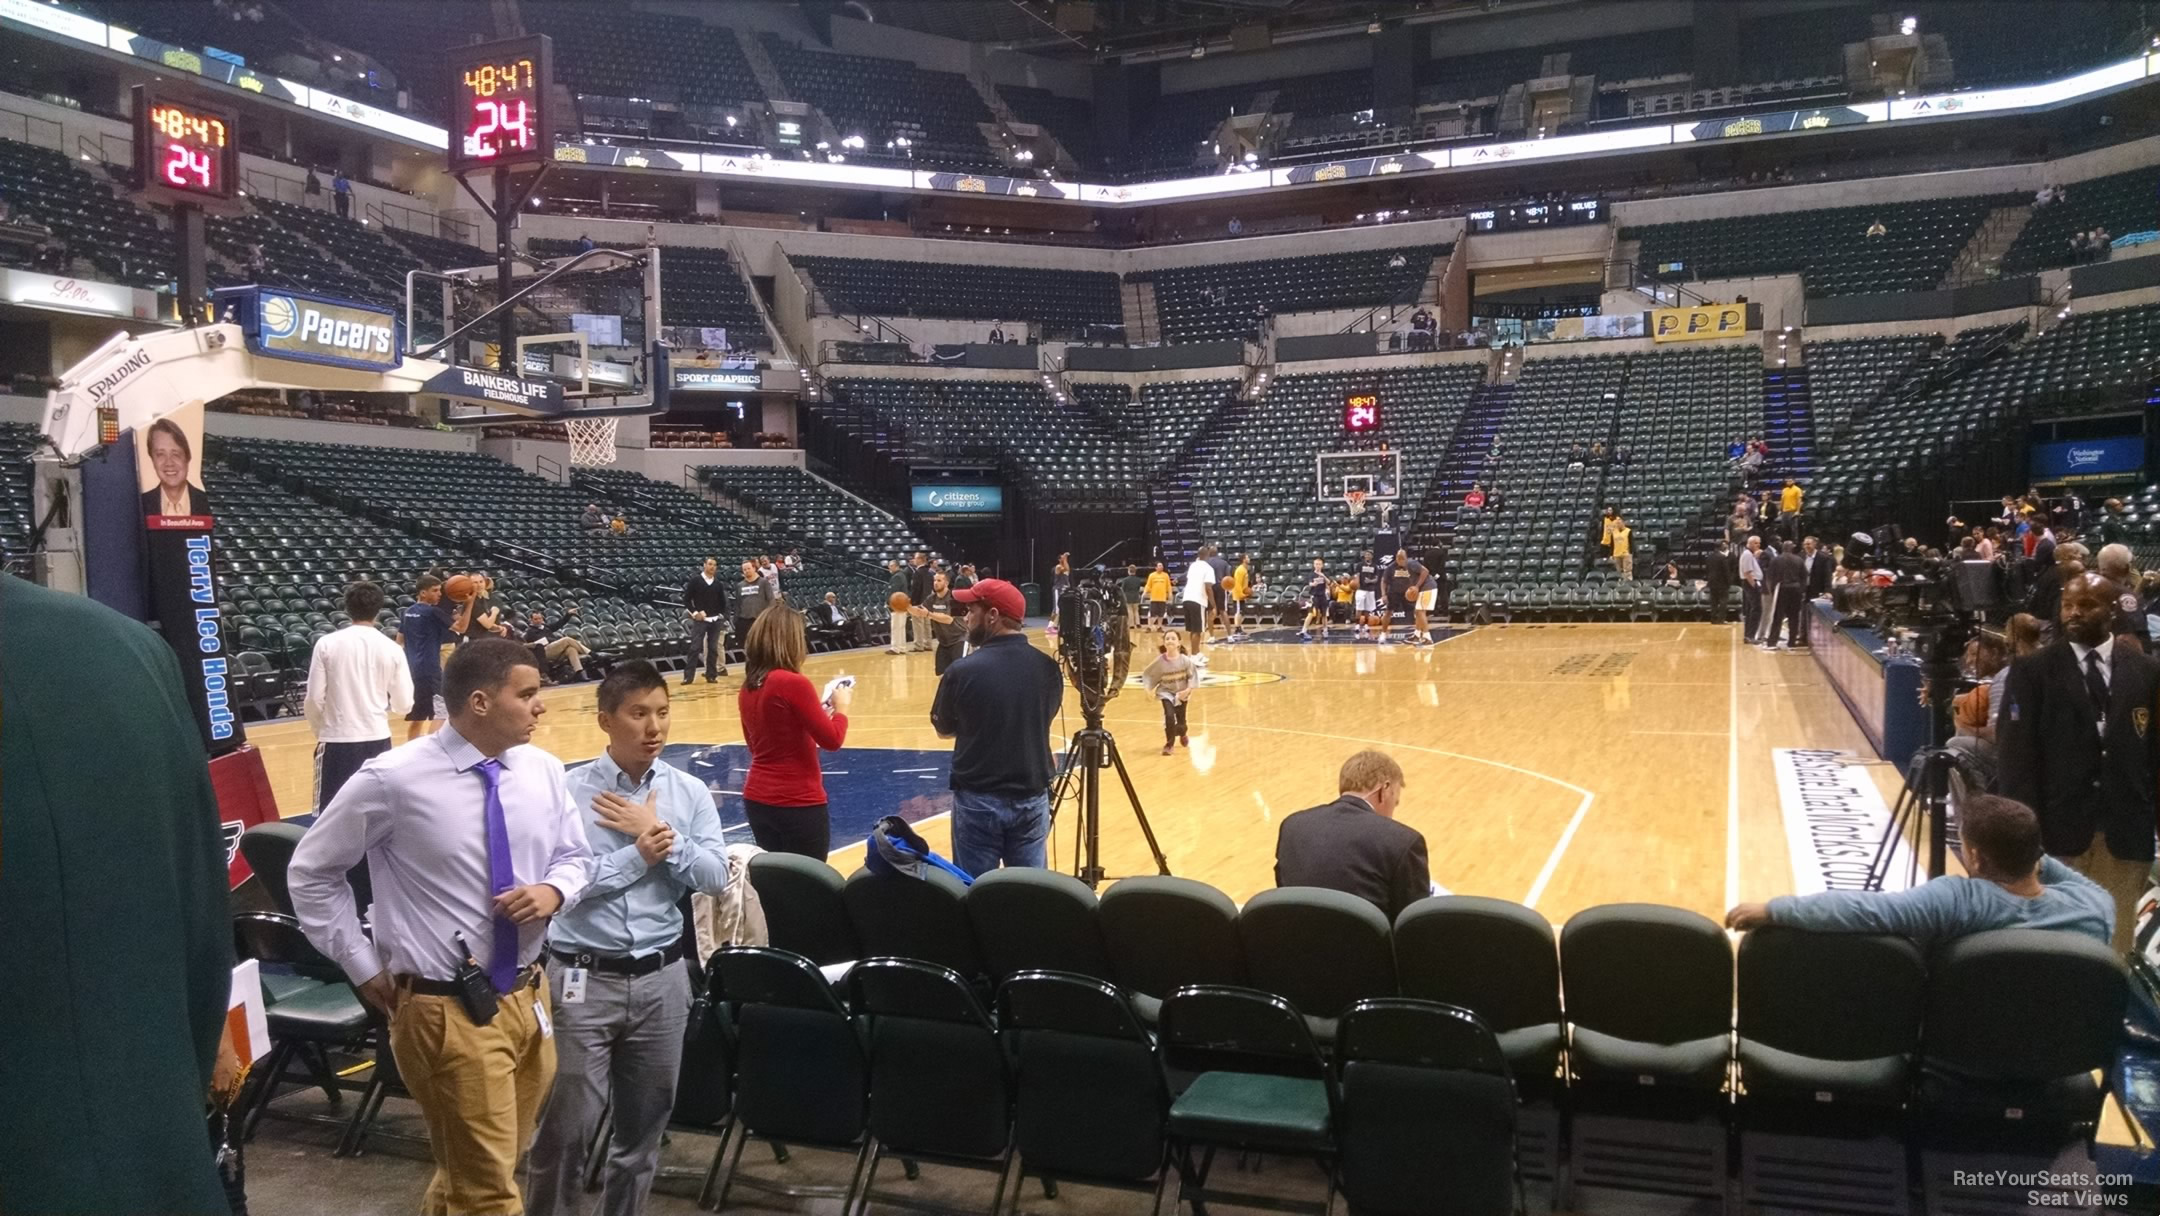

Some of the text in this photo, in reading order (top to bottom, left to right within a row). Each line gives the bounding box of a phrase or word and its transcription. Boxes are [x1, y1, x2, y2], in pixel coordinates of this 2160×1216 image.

[464, 61, 532, 96] 48:47
[152, 107, 225, 147] 48:47
[475, 101, 527, 157] 24
[168, 144, 210, 187] 24
[1470, 211, 1495, 220] PACERS
[301, 309, 391, 353] Pacers
[87, 348, 152, 404] SPALDING
[463, 371, 547, 399] BANKERS LIFE
[676, 373, 760, 384] SPORT GRAPHICS
[484, 388, 529, 405] FIELDHOUSE
[1349, 396, 1376, 407] 48:47
[1351, 407, 1374, 427] 24
[944, 492, 980, 500] citizens
[186, 535, 234, 740] Terry Lee Honda
